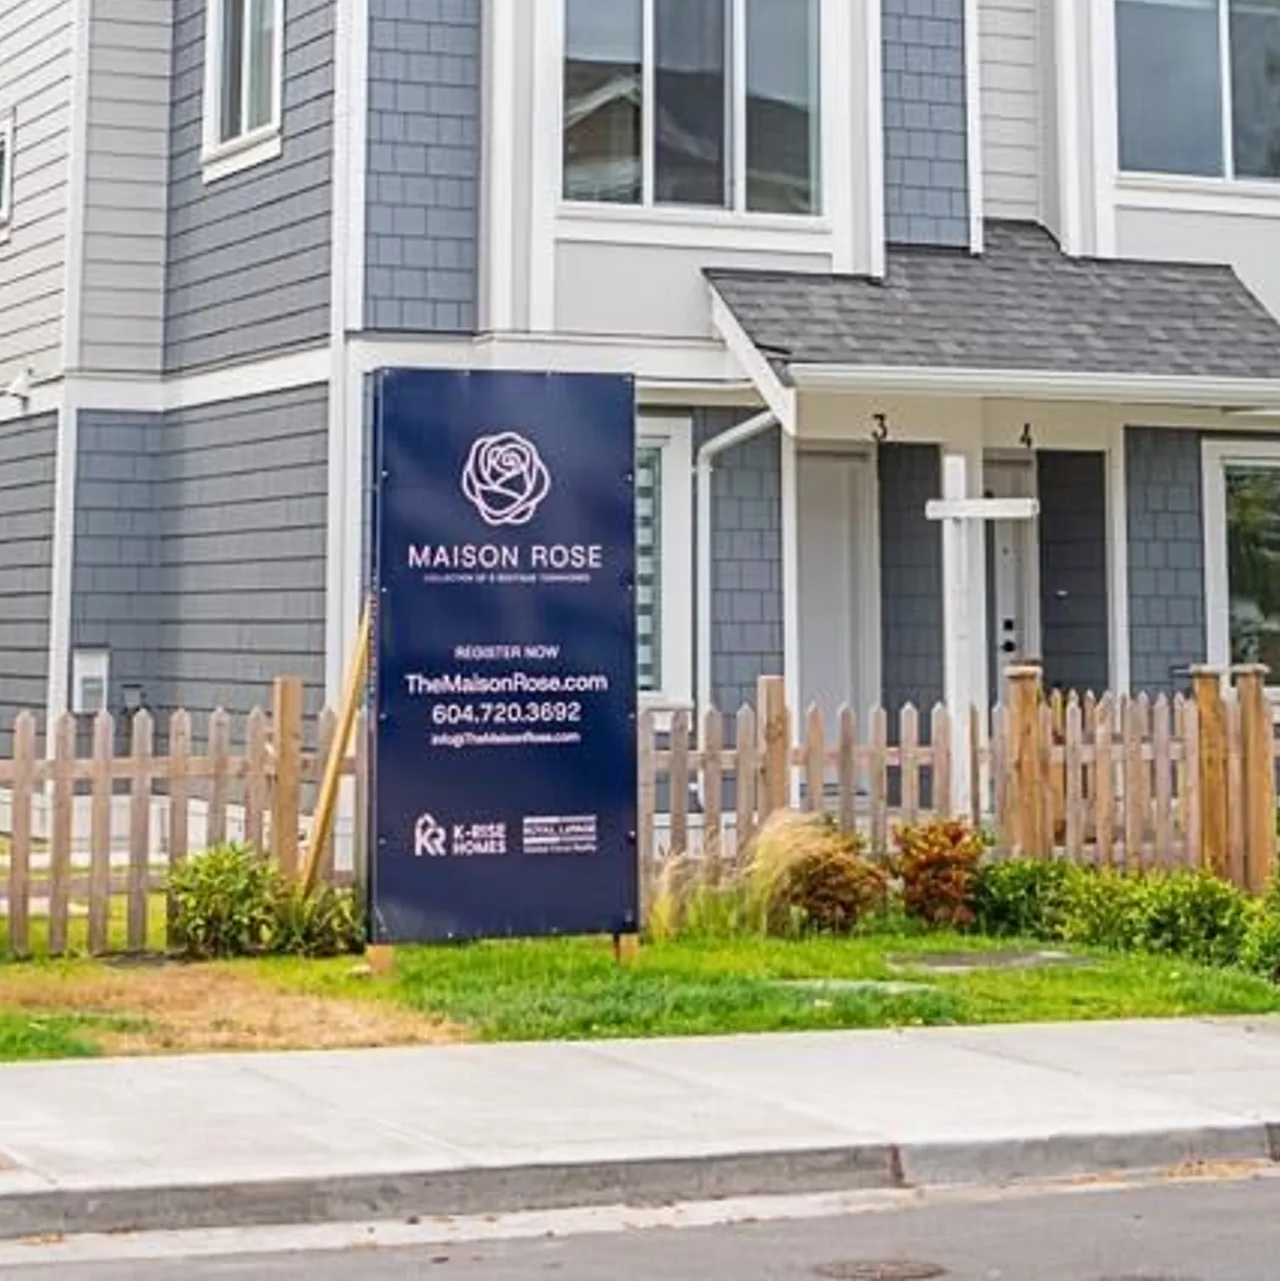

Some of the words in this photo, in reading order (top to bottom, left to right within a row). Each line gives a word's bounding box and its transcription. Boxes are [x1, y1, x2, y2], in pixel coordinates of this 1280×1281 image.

[872, 413, 888, 440] 3
[1020, 423, 1032, 448] 4
[408, 544, 519, 568] MAISON
[531, 545, 603, 568] ROSE
[454, 645, 521, 660] REGISTER
[524, 645, 560, 659] NOW
[405, 672, 608, 694] TheMaisonRose.com
[453, 839, 507, 856] HOMES
